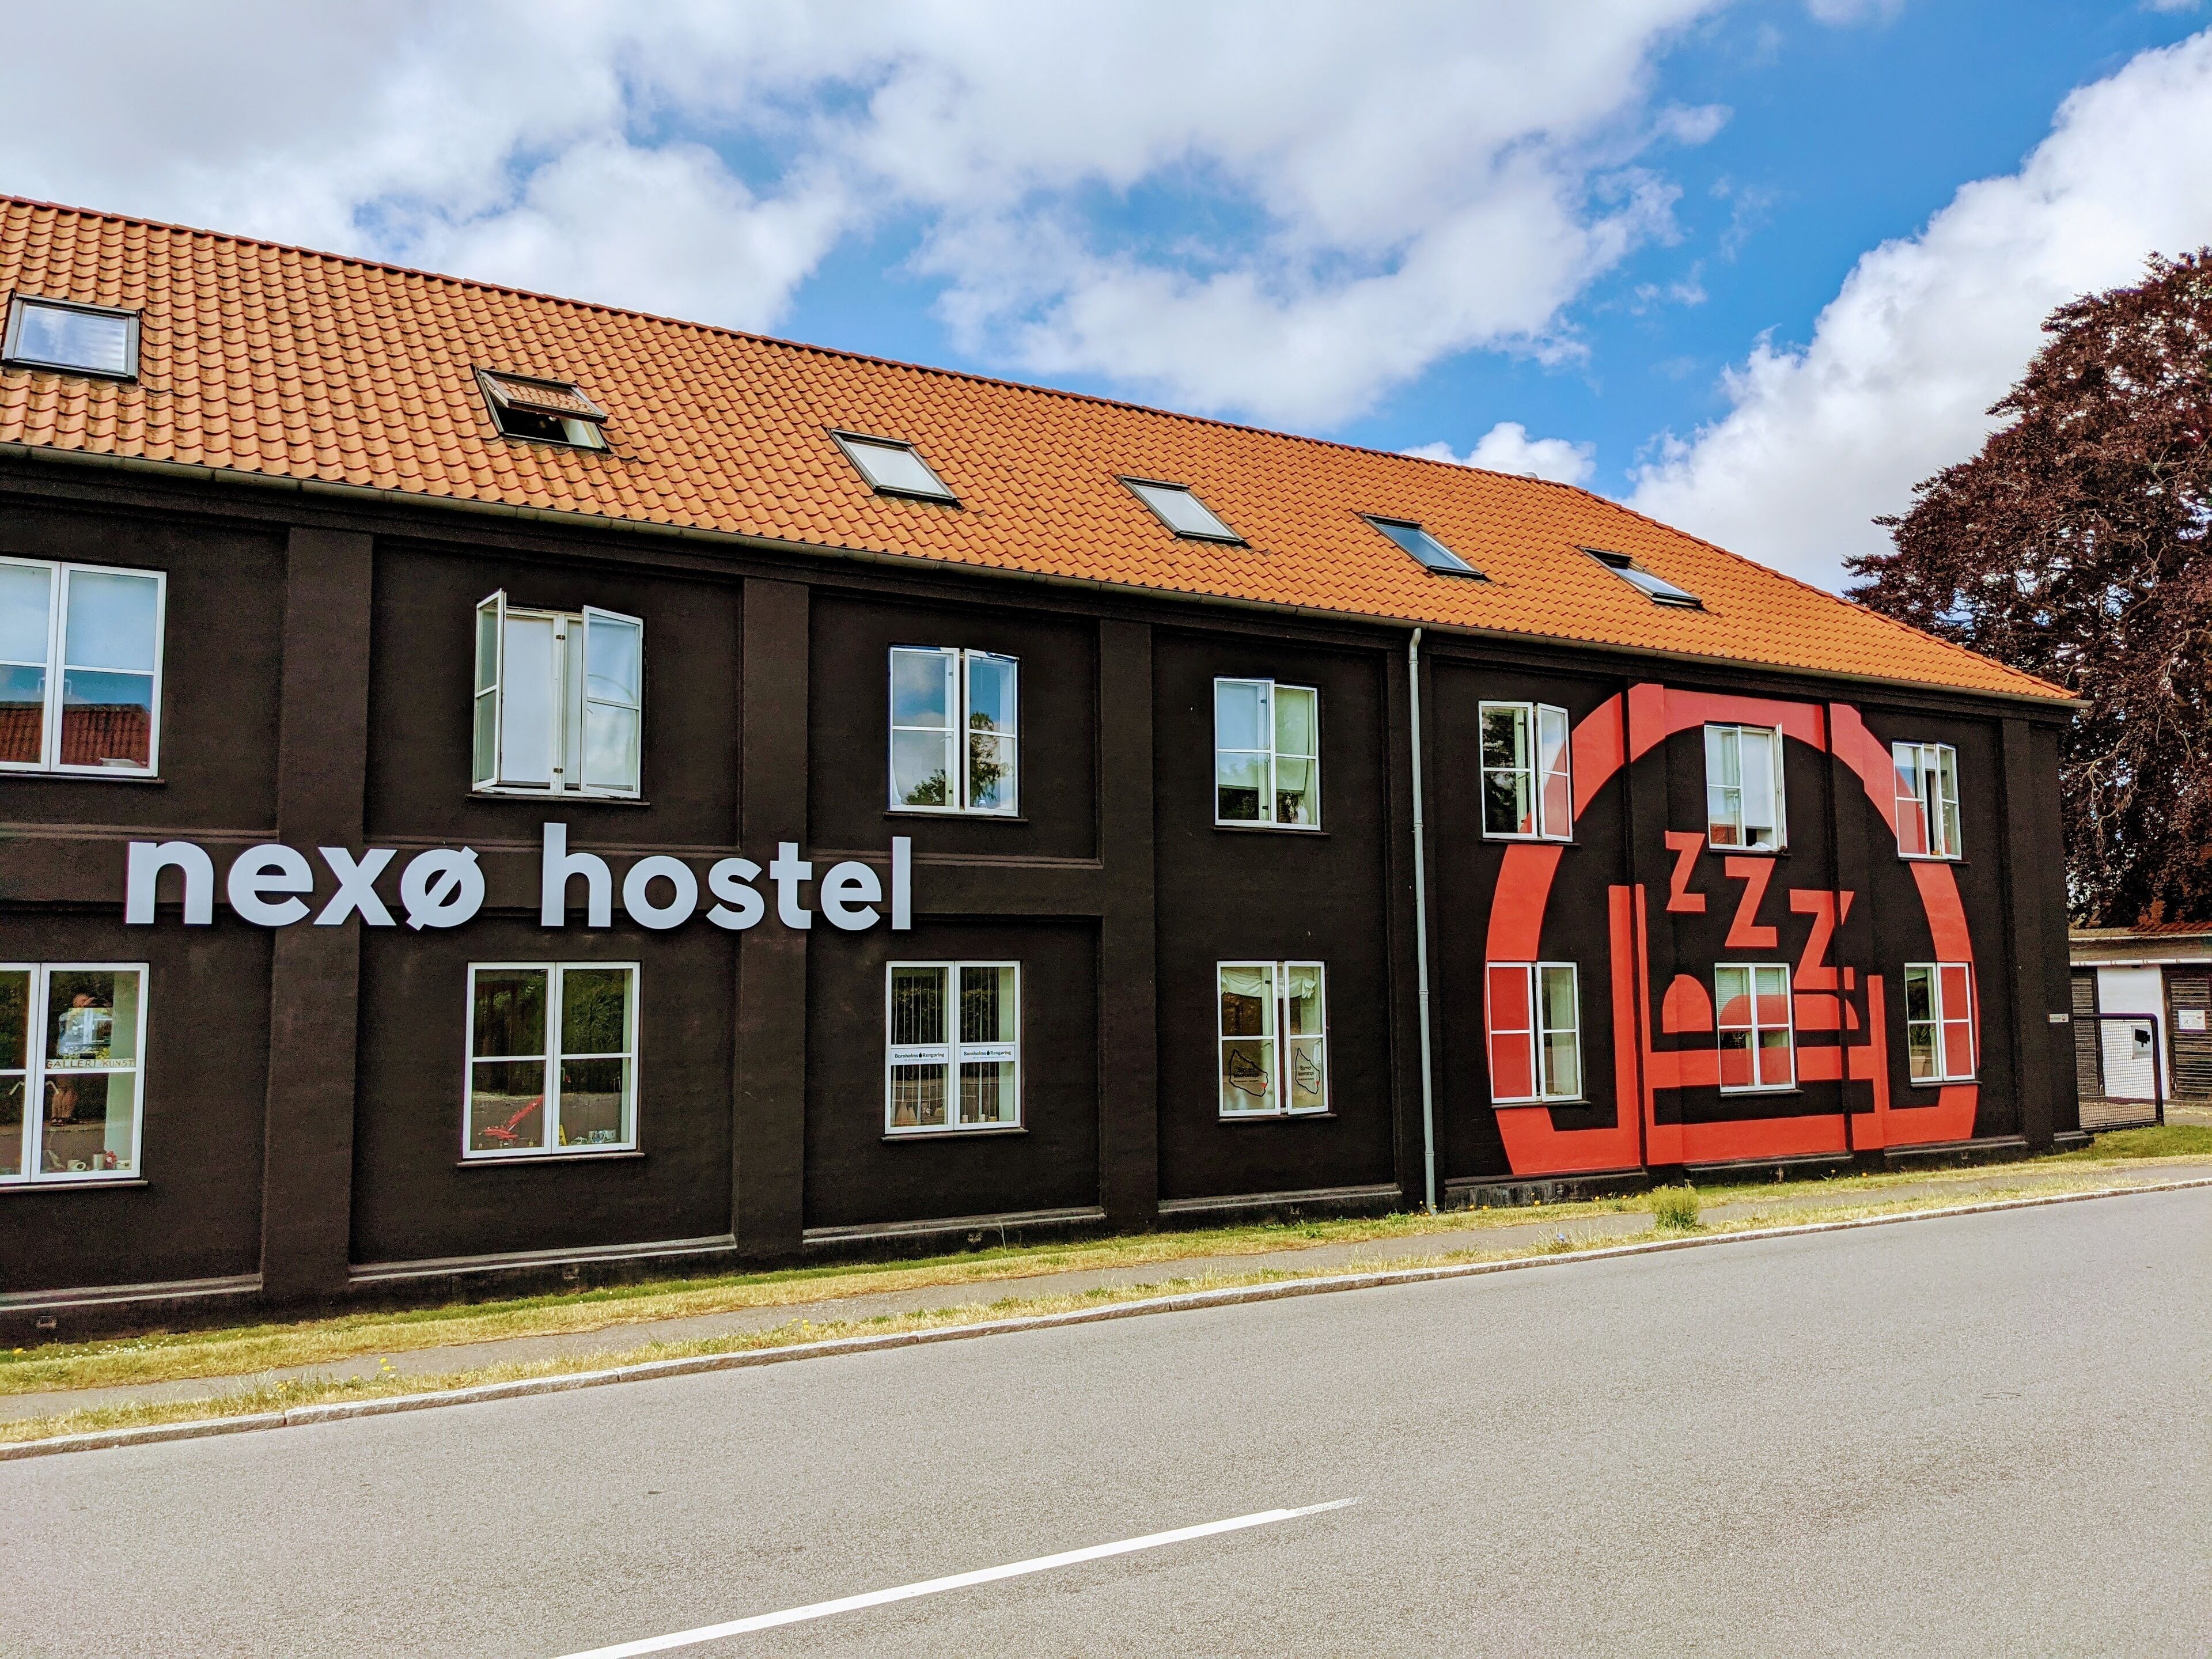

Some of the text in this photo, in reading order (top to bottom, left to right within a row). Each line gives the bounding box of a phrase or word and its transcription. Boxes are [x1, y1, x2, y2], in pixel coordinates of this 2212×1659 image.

[125, 822, 911, 931] nexø hostel
[46, 1059, 96, 1068] GALLERI
